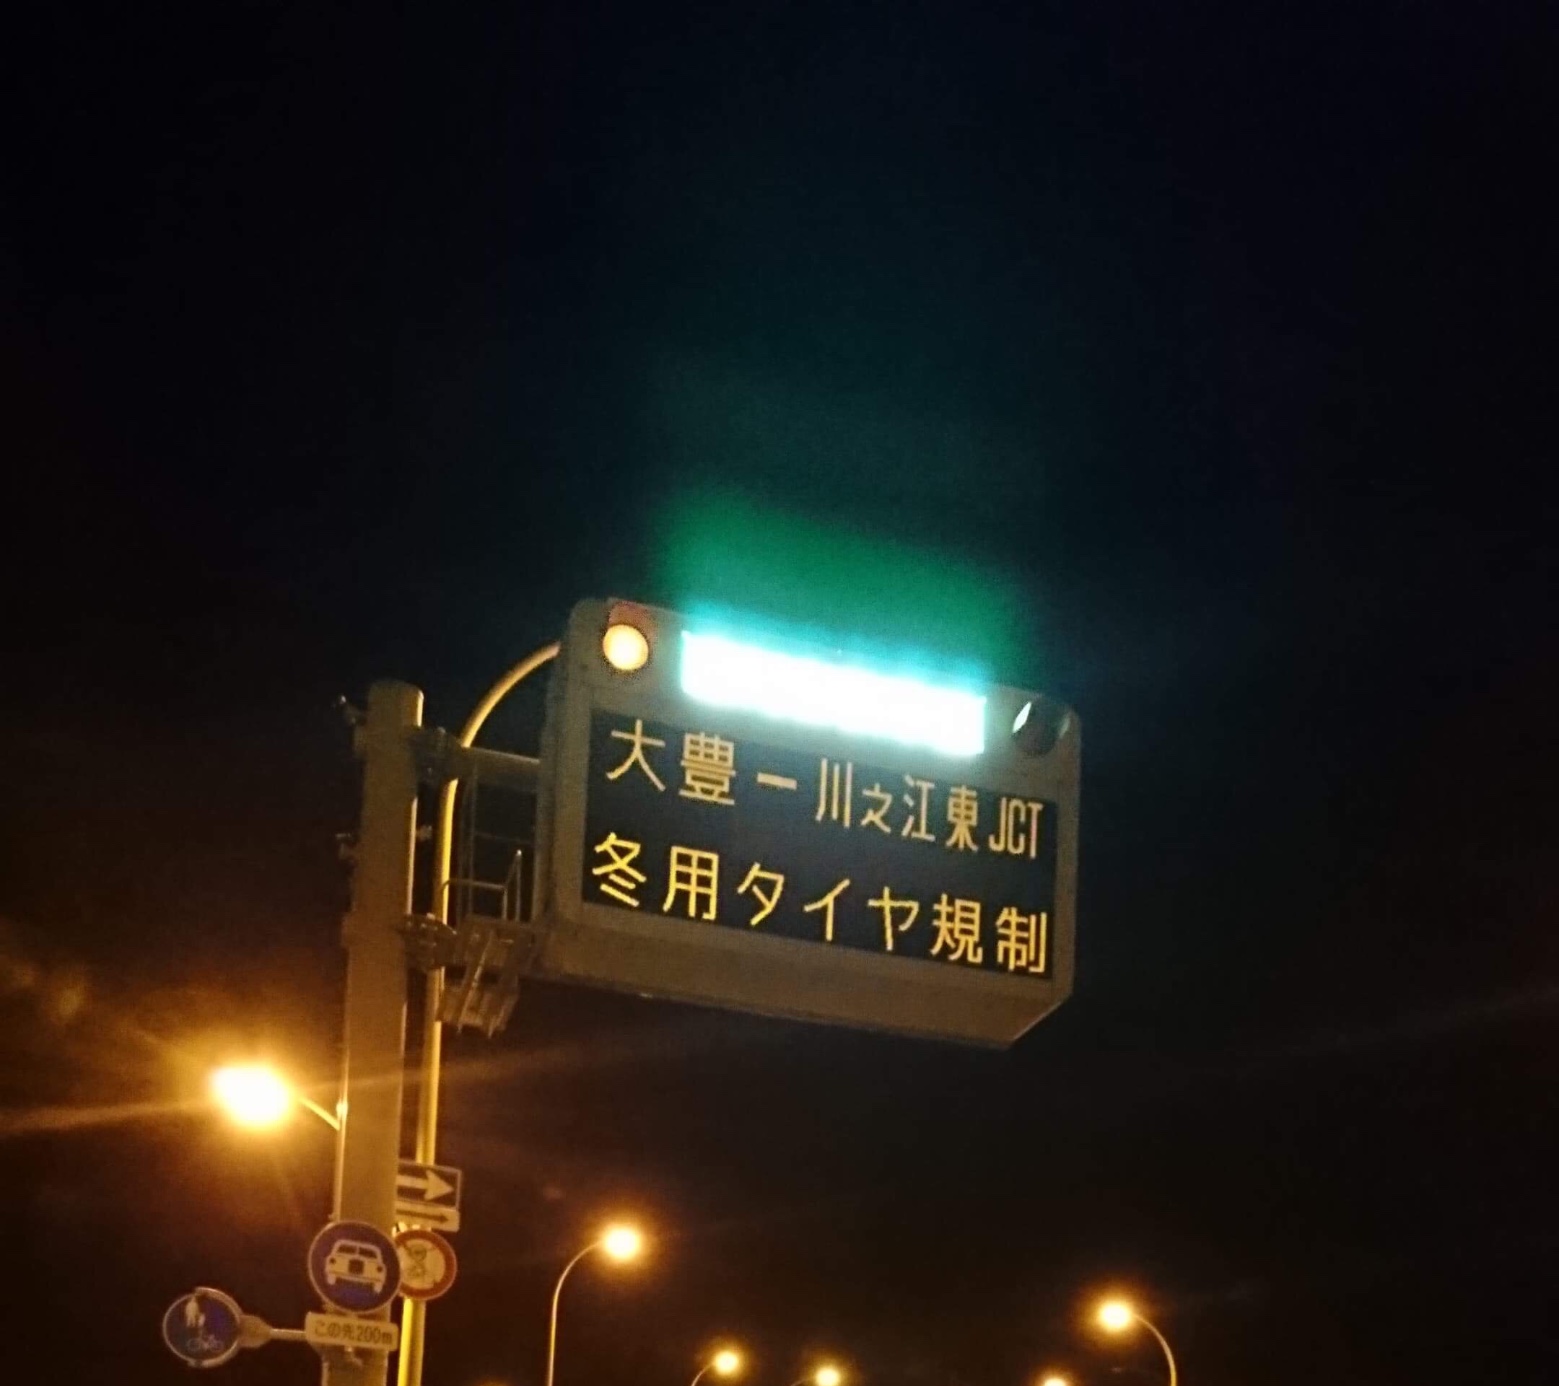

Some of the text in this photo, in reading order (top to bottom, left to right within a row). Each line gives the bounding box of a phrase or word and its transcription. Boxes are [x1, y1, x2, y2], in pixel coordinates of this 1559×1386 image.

[592, 832, 1048, 973] 冬用タイヤ規制
[315, 1321, 393, 1345] この先200m
